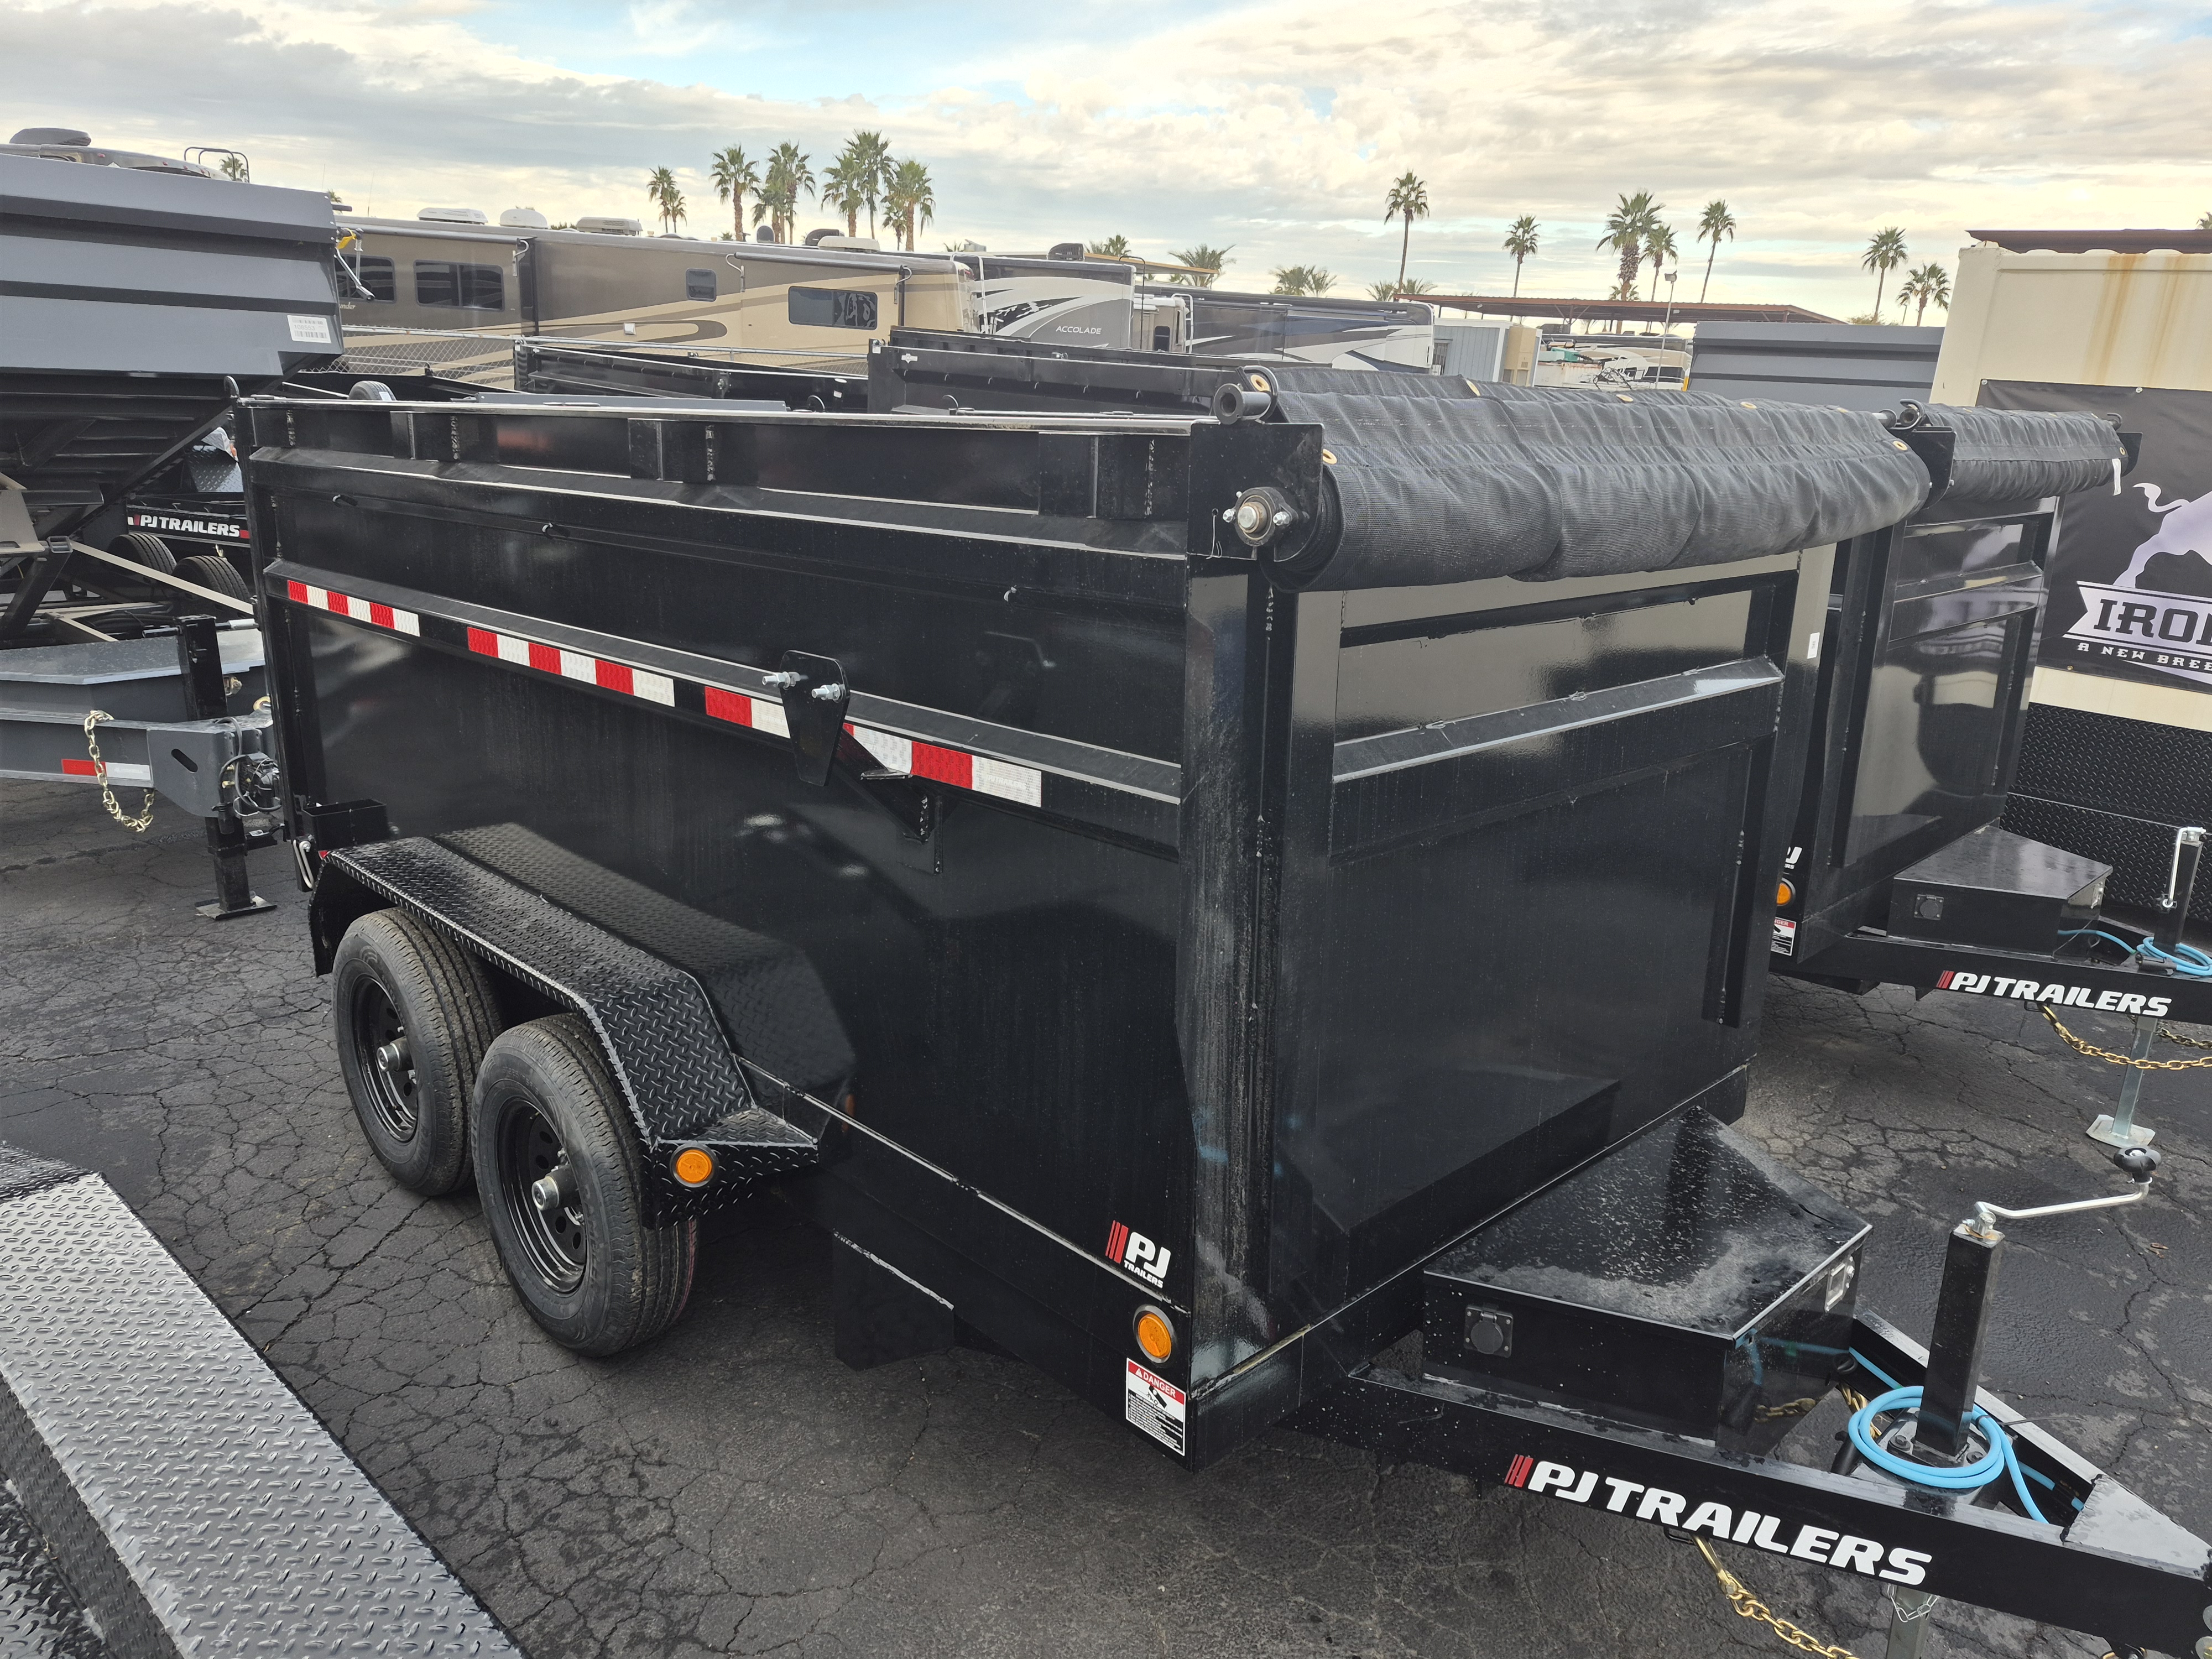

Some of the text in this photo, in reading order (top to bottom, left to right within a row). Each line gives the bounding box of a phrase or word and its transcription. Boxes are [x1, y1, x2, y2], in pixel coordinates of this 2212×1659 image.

[1056, 326, 1102, 335] ACCOLADE
[140, 515, 240, 538] PJ TRAILERS
[2077, 643, 2090, 652] A
[2101, 646, 2146, 660] NEW
[1949, 972, 2172, 1017] PJ TRAILERS
[1125, 1232, 1171, 1279] PJ
[1124, 1260, 1164, 1288] TRAILERS
[1143, 1373, 1176, 1399] DANGER
[1528, 1460, 1932, 1585] PJ TRAILERS
